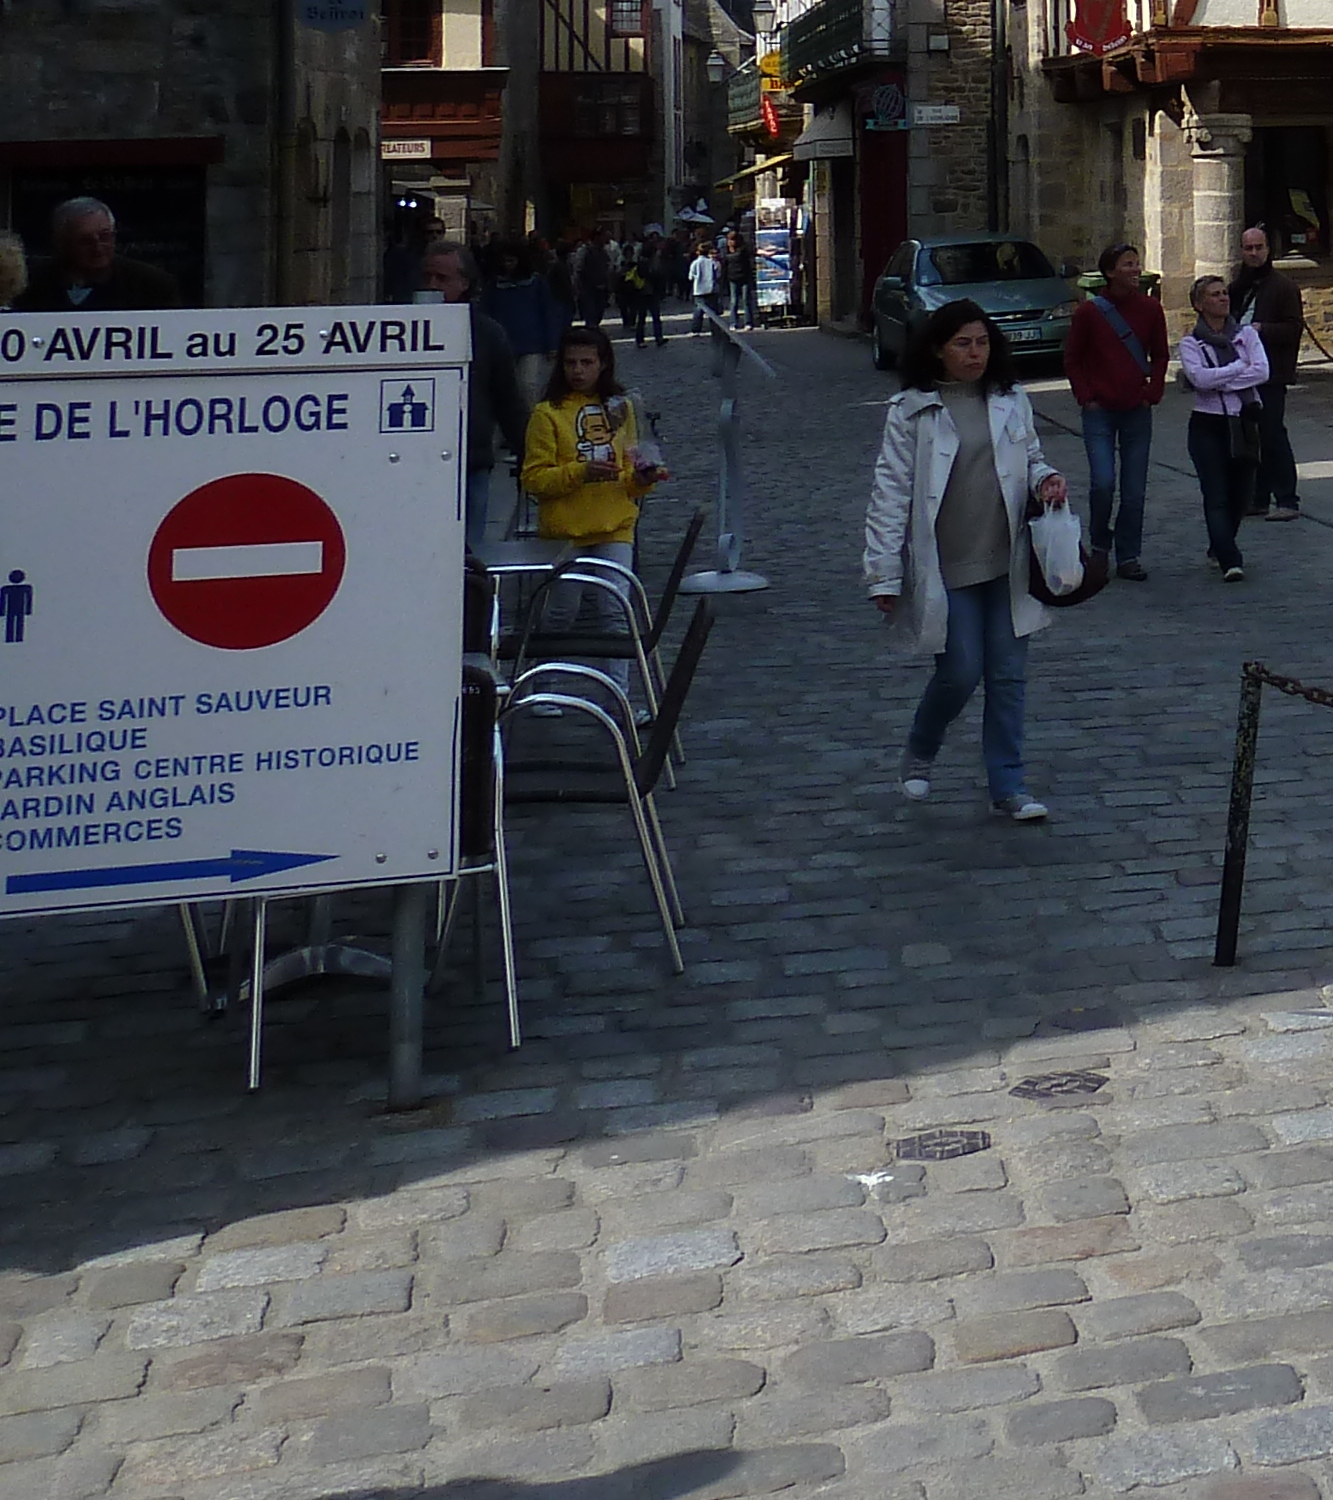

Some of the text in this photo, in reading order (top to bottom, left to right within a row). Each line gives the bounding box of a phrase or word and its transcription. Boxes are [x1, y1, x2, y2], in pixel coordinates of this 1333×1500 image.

[1, 319, 444, 362] 0 AVRIL au 25 AVRIL
[0, 393, 350, 441] E DE L'HORLOGE
[97, 695, 186, 722] SAINT
[195, 685, 332, 716] SAUVEUR
[0, 740, 420, 790] ARKING CENTRE HISTORIQUE
[105, 782, 235, 813] ANGLAIS
[0, 817, 183, 852] OMMERCES
